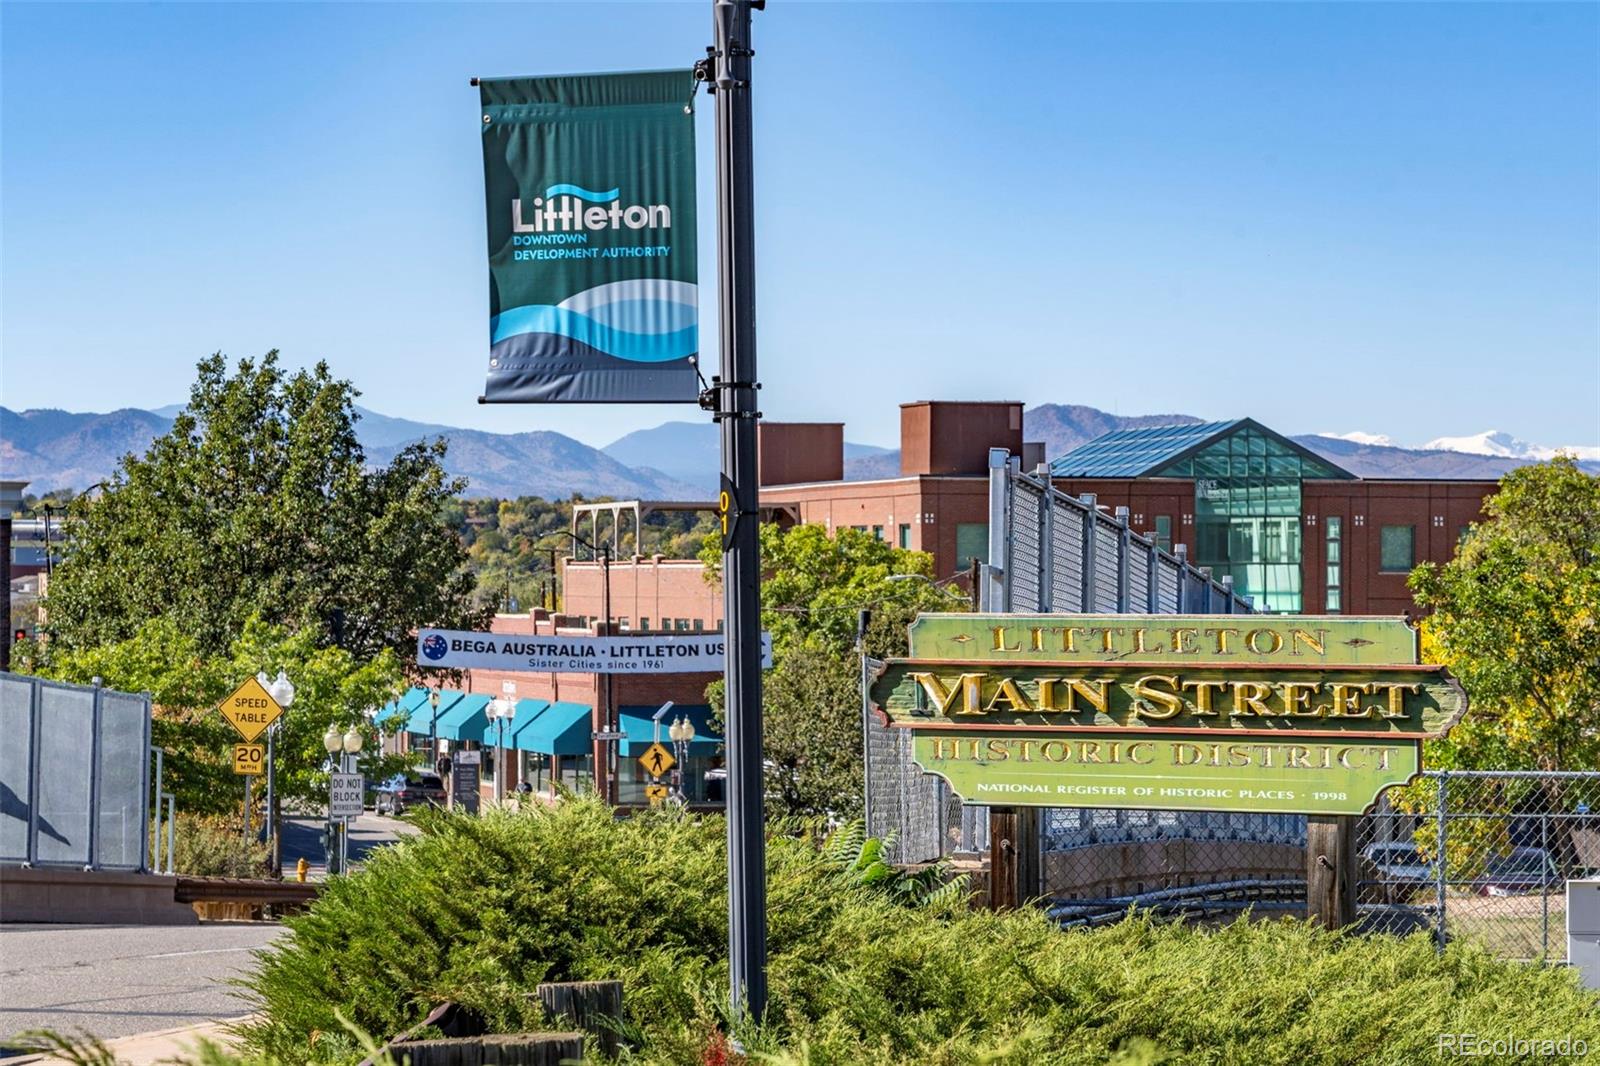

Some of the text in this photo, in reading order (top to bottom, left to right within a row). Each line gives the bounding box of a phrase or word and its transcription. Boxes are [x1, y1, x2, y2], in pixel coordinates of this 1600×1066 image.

[511, 195, 671, 233] Littleton
[512, 233, 587, 246] DOWNTOWN
[514, 246, 671, 260] DEVELOPMENT AUTHORITY
[451, 639, 725, 657] BEGA AUSTRALIA LITTLETON US
[988, 625, 1332, 657] LITTLETON
[528, 658, 664, 670] Sister Cities since 1961
[235, 698, 268, 709] SPEED
[906, 672, 1421, 720] MAIN STREET
[235, 712, 267, 723] TABLE
[237, 747, 261, 763] 20
[930, 737, 1399, 772] HISTORIC DISTRICT
[333, 779, 361, 789] DO NOT
[333, 792, 361, 802] BLOCK
[977, 783, 1348, 801] NATIONAL REGISTER OF HISTORIC PLACES 1998
